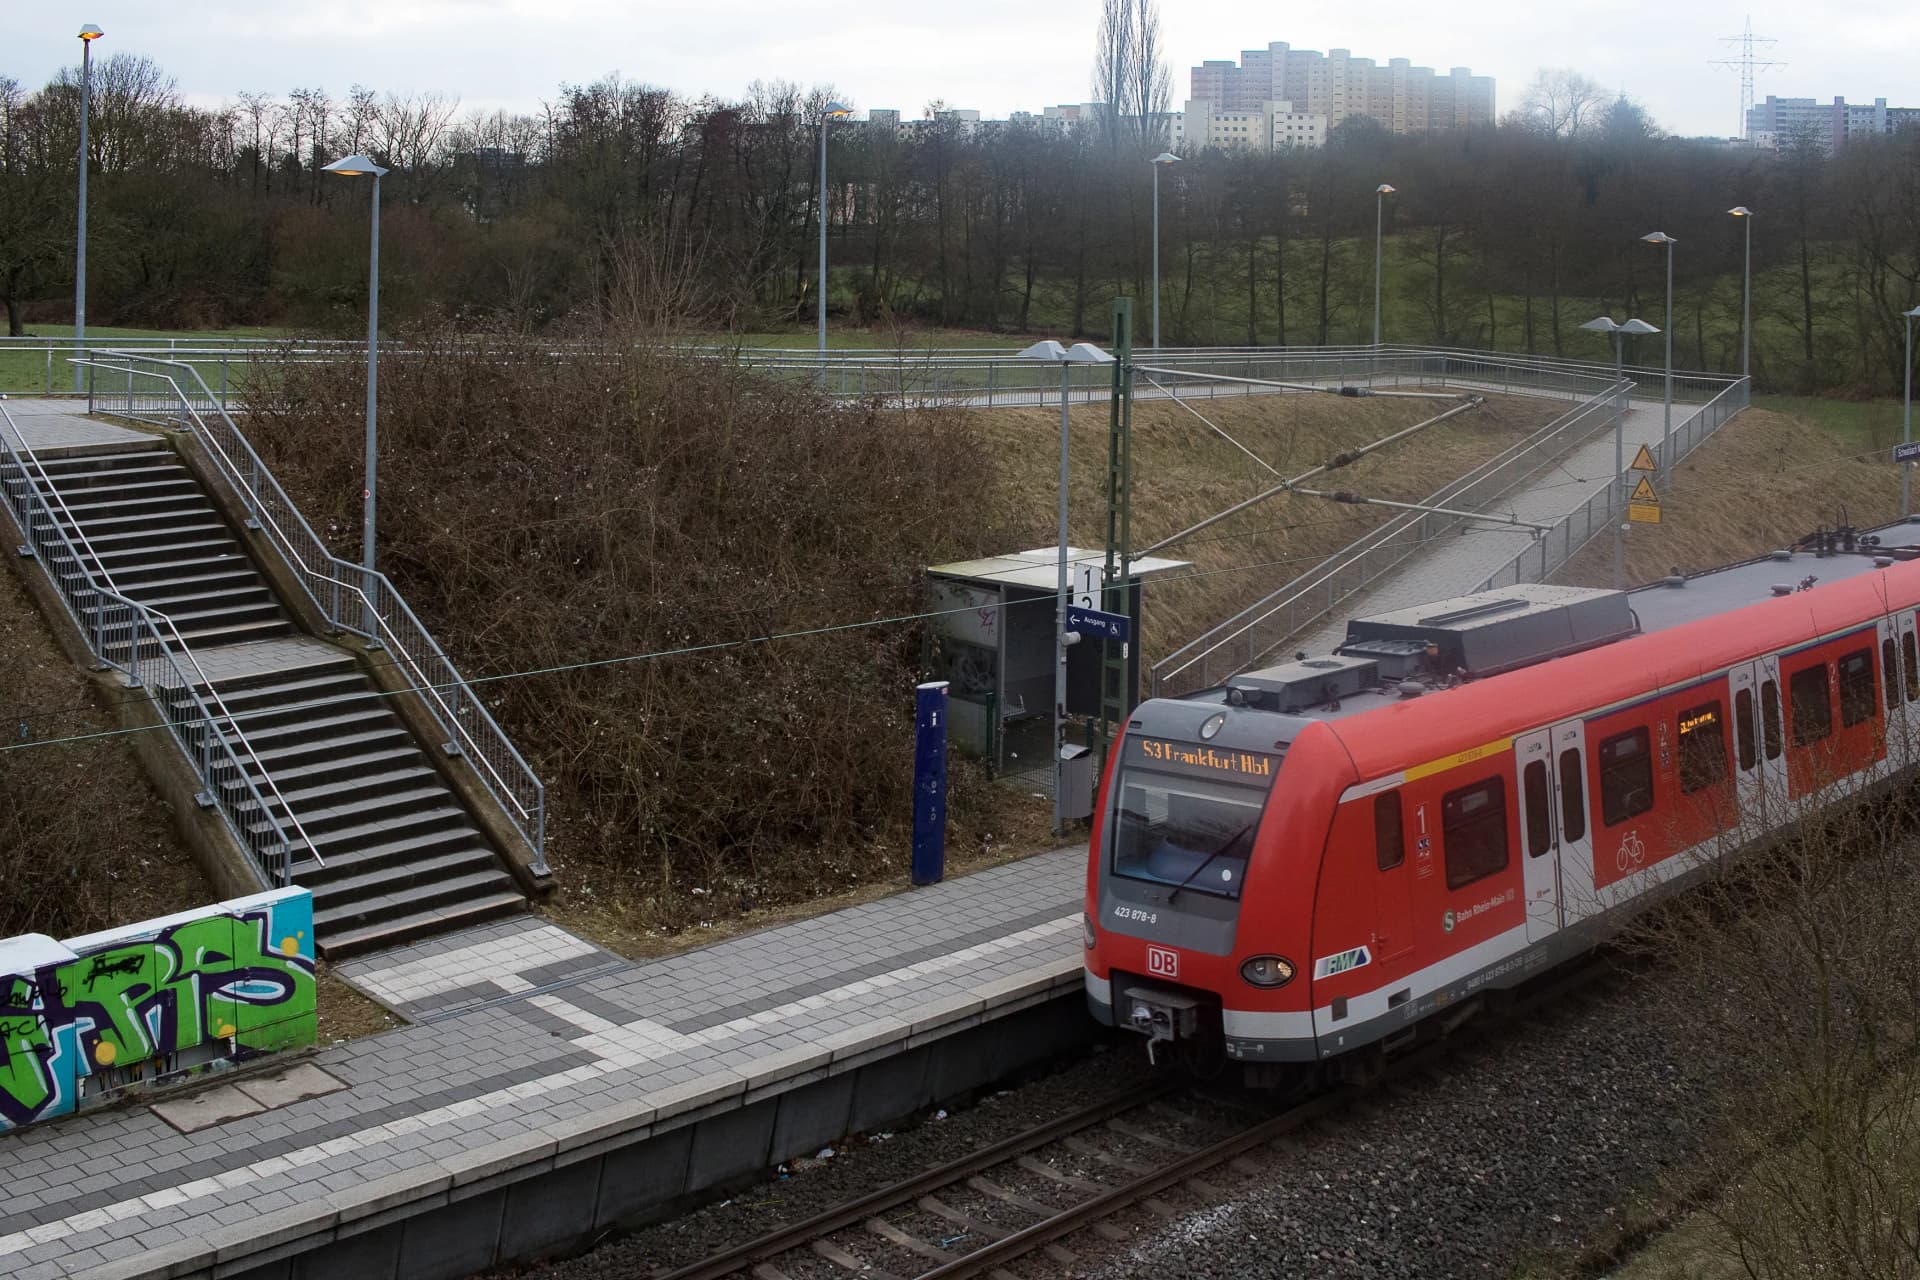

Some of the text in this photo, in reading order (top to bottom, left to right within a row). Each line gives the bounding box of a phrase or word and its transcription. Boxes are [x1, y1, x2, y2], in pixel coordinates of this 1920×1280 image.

[1084, 569, 1091, 593] 1
[1083, 616, 1106, 628] Ausgang
[1143, 740, 1162, 759] S3
[1164, 743, 1239, 771] Frankfurt
[1416, 805, 1426, 834] 1
[1114, 905, 1157, 924] 423 878-8
[1444, 911, 1455, 932] S
[1456, 908, 1473, 923] Bahn
[1472, 894, 1505, 915] Rhein-Main
[1150, 949, 1177, 976] DB
[1327, 949, 1361, 974] RMV
